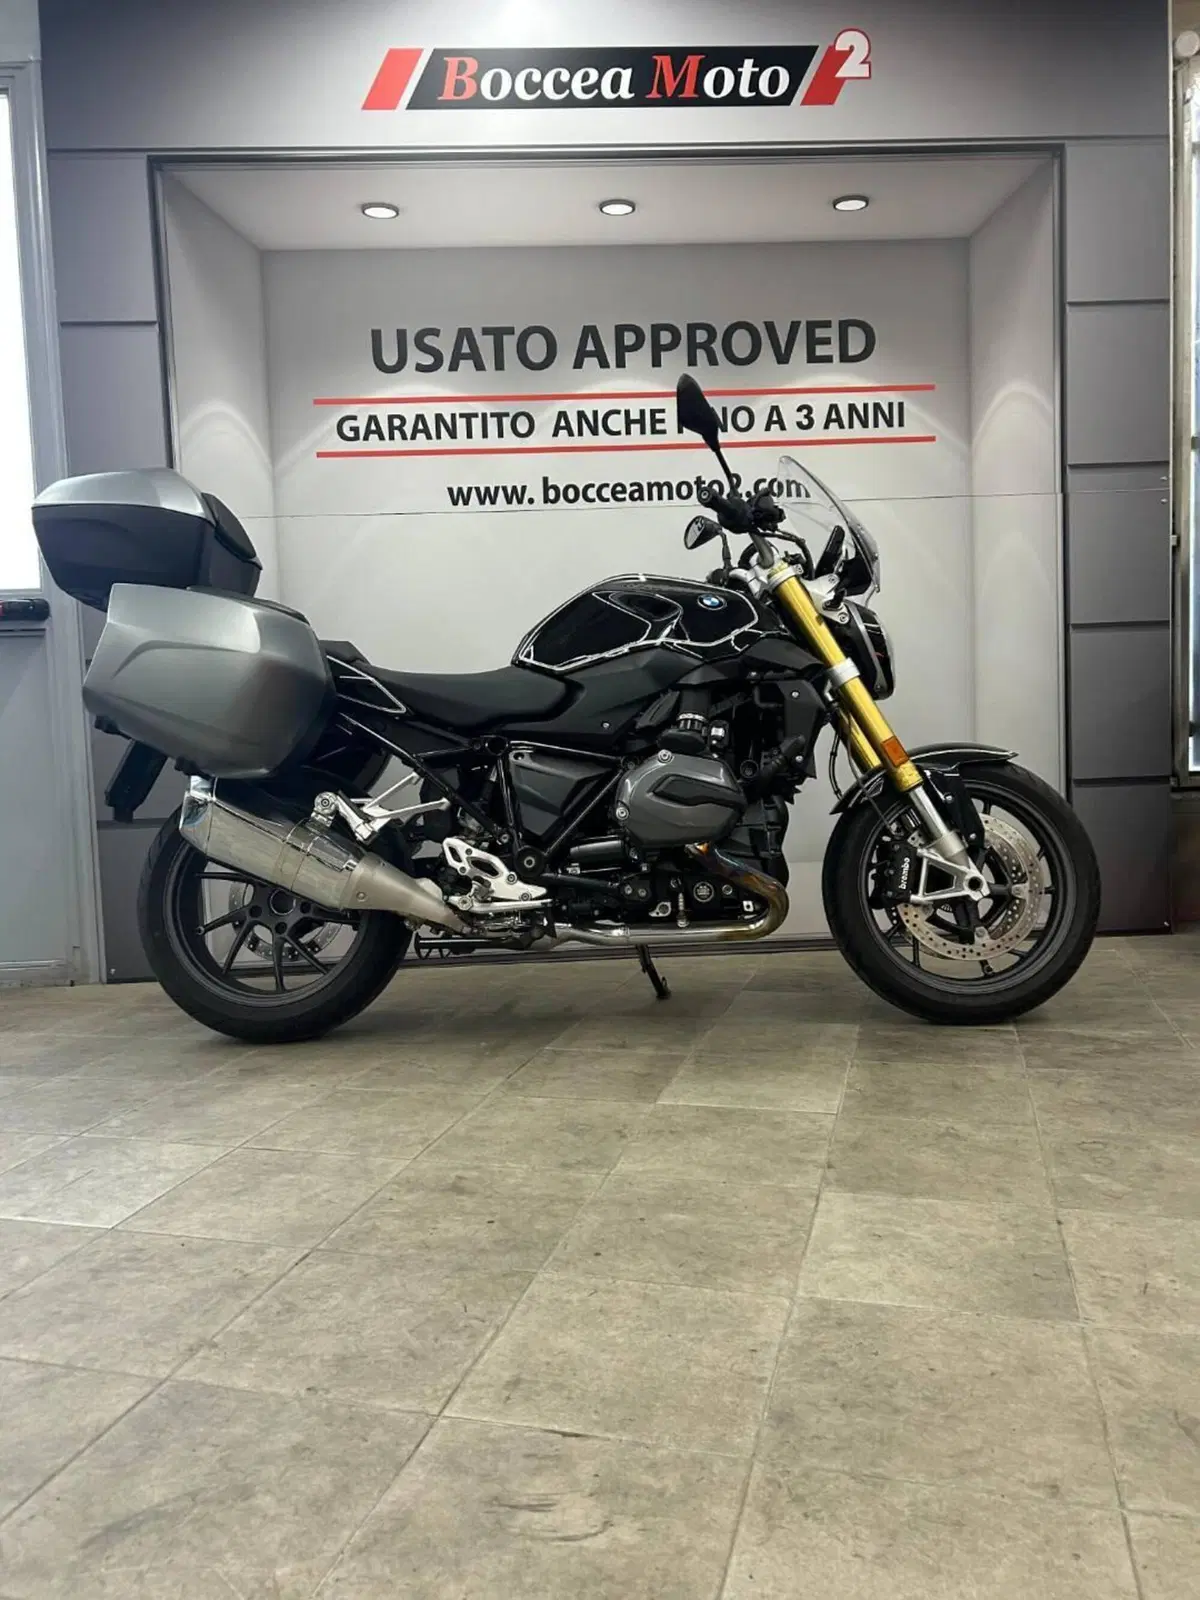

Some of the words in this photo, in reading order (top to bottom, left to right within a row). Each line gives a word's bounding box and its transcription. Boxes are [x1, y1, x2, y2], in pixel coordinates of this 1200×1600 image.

[437, 56, 634, 101] Boccea
[646, 54, 791, 99] Moto
[834, 28, 872, 79] 2
[370, 325, 558, 374] USATO
[572, 318, 876, 370] APPROVED
[336, 411, 536, 442] GARANTITO
[551, 407, 667, 437] ANCHE
[676, 404, 755, 435] NO
[764, 404, 787, 432] A
[795, 404, 815, 431] 3
[823, 401, 905, 430] ANNI
[898, 857, 911, 890] brembo
